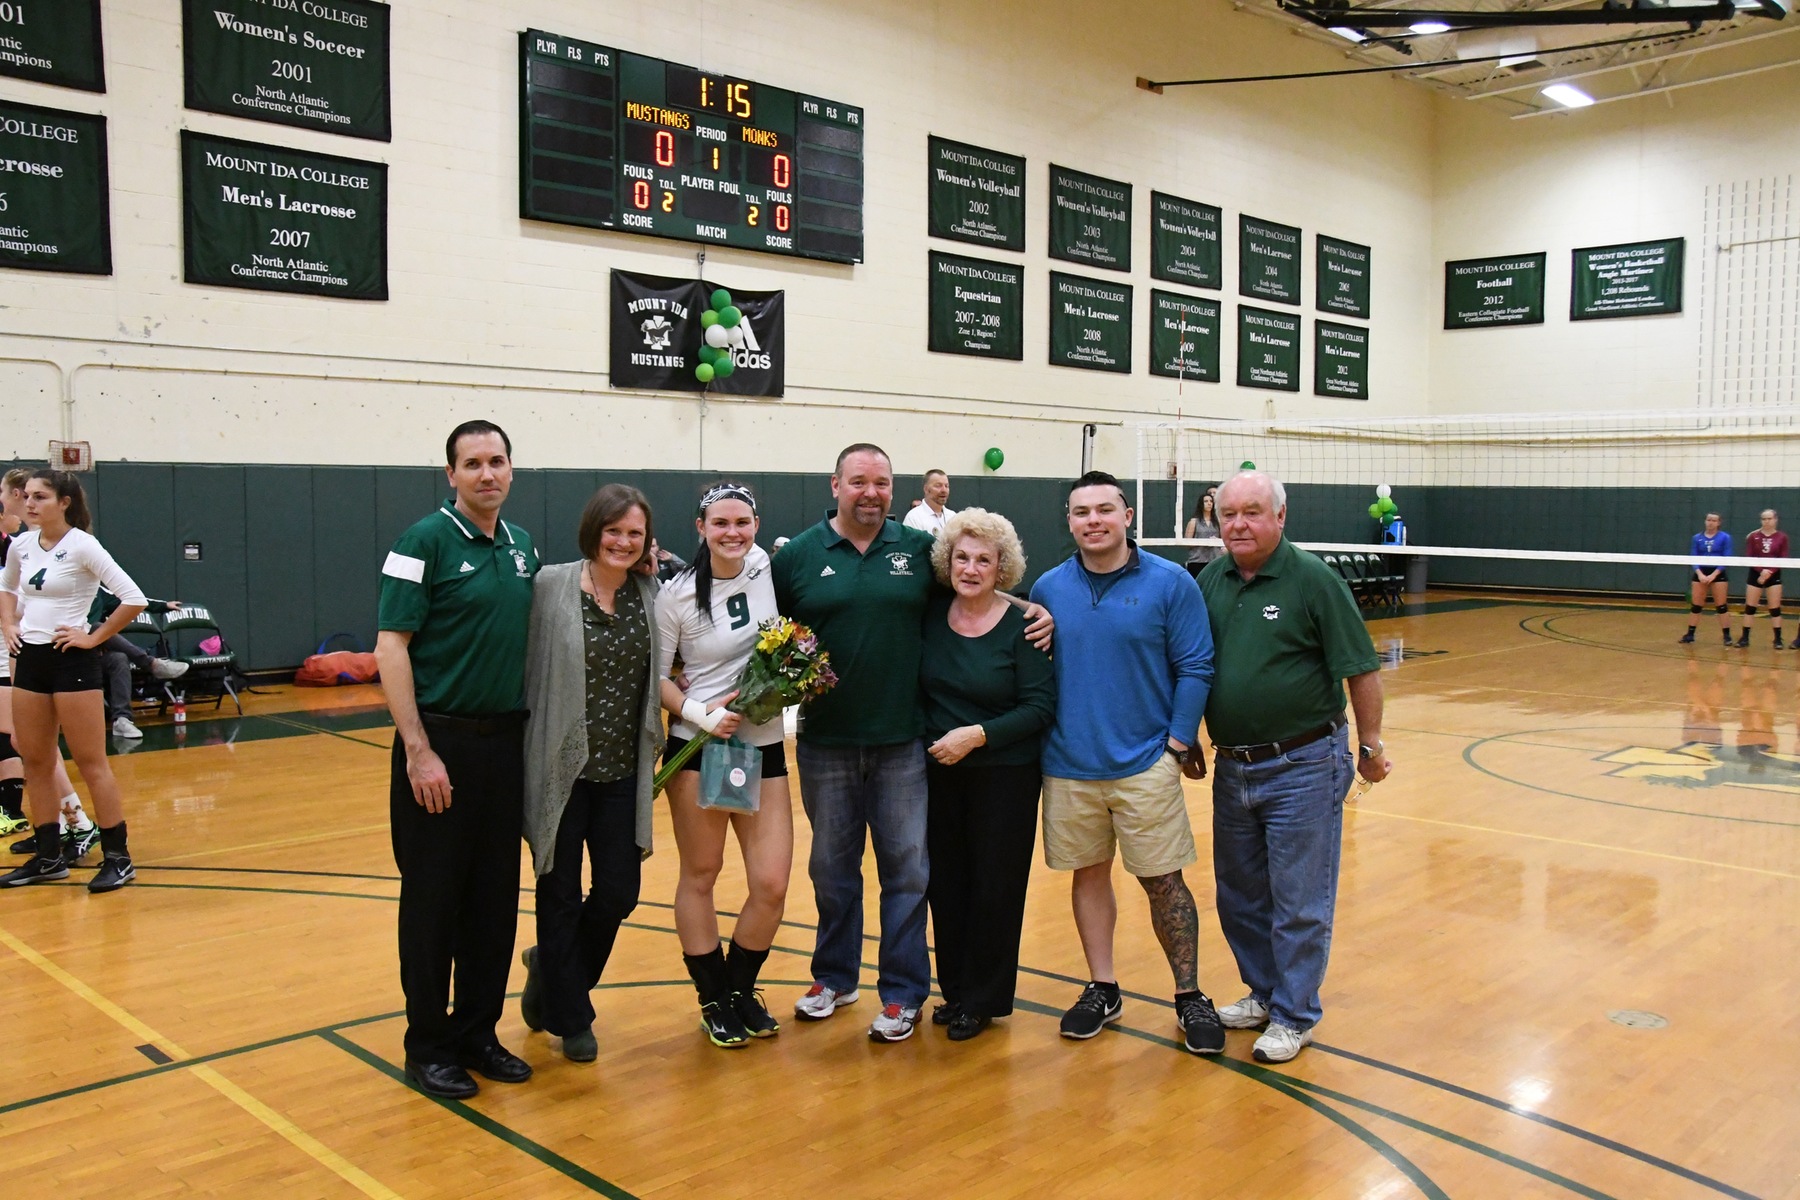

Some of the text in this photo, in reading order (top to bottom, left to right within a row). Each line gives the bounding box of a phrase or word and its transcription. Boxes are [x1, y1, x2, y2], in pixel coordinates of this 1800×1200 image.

[272, 0, 368, 28] IDA COLLEGE
[214, 11, 365, 59] Women's Soccer
[537, 39, 609, 67] PLYR FLS PTS
[272, 60, 312, 83] 2001
[256, 85, 329, 109] North Atlantic
[701, 78, 750, 118] 1:15
[232, 93, 350, 124] Conference Champions
[626, 102, 689, 130] MUSTANGS
[803, 101, 858, 124] PLYR FLS PTS
[696, 126, 726, 142] PERIOD
[743, 126, 777, 148] MONKS
[656, 130, 673, 167] 0
[713, 148, 719, 170] 1
[941, 149, 1015, 175] MOUNT IDA COLLEGE
[206, 152, 369, 189] MOUNT IDA COLLEGE
[623, 164, 653, 181] FOULS
[774, 154, 789, 188] 0
[681, 175, 740, 195] PLAYER FOUL
[936, 168, 1020, 197] Women's Volleyball
[1058, 176, 1124, 201] MOUNT IDA COLLEGE
[222, 185, 356, 219] Men's Lacrosse
[634, 181, 649, 209] 0
[662, 192, 674, 213] 2
[766, 190, 792, 204] FOULS
[748, 206, 759, 226] 2
[969, 200, 989, 215] 2002
[1056, 195, 1125, 222] Women's Volleyball
[1160, 201, 1180, 213] MOUNT
[1182, 206, 1191, 216] IDA
[623, 213, 653, 229] SCORE
[776, 205, 789, 231] 0
[270, 229, 310, 248] 2007
[696, 225, 726, 240] MATCH
[1160, 218, 1216, 241] Women's Volleyball
[766, 235, 792, 249] SCORE
[1180, 245, 1196, 256] 2004
[252, 254, 328, 272] North Atlantic
[1589, 253, 1615, 261] MOUNT
[1630, 248, 1664, 257] COLLEGE
[231, 264, 348, 286] Conference Champions
[939, 262, 1016, 284] MOUNT IDA COLLEGE
[1456, 266, 1484, 275] MOUNT
[1500, 262, 1535, 270] COLLEGE
[1589, 262, 1622, 270] Women's
[1059, 283, 1124, 302] MOUNT IDA COLLEGE
[1477, 277, 1512, 288] Football
[955, 286, 1001, 304] Equestrian
[1483, 295, 1504, 305] 2012
[628, 298, 688, 320] MOUNT IDA
[1064, 303, 1119, 321] Men's Lacrosse
[1159, 299, 1180, 311] MOUNT
[1191, 305, 1215, 317] COLLEGE
[955, 311, 1000, 327] 2007 2008
[1246, 315, 1263, 325] MOUNT
[1274, 320, 1295, 330] COLLEGE
[1084, 329, 1101, 341] 2008
[1250, 332, 1265, 343] Men's
[631, 353, 684, 368] MUSTANGS
[729, 347, 771, 369] idas
[1762, 544, 1770, 553] 3
[28, 568, 47, 590] 4
[137, 612, 152, 624] IDA
[166, 608, 210, 623] MOUNT IDA
[726, 592, 750, 631] 9
[192, 656, 230, 665] MUSTANGS
